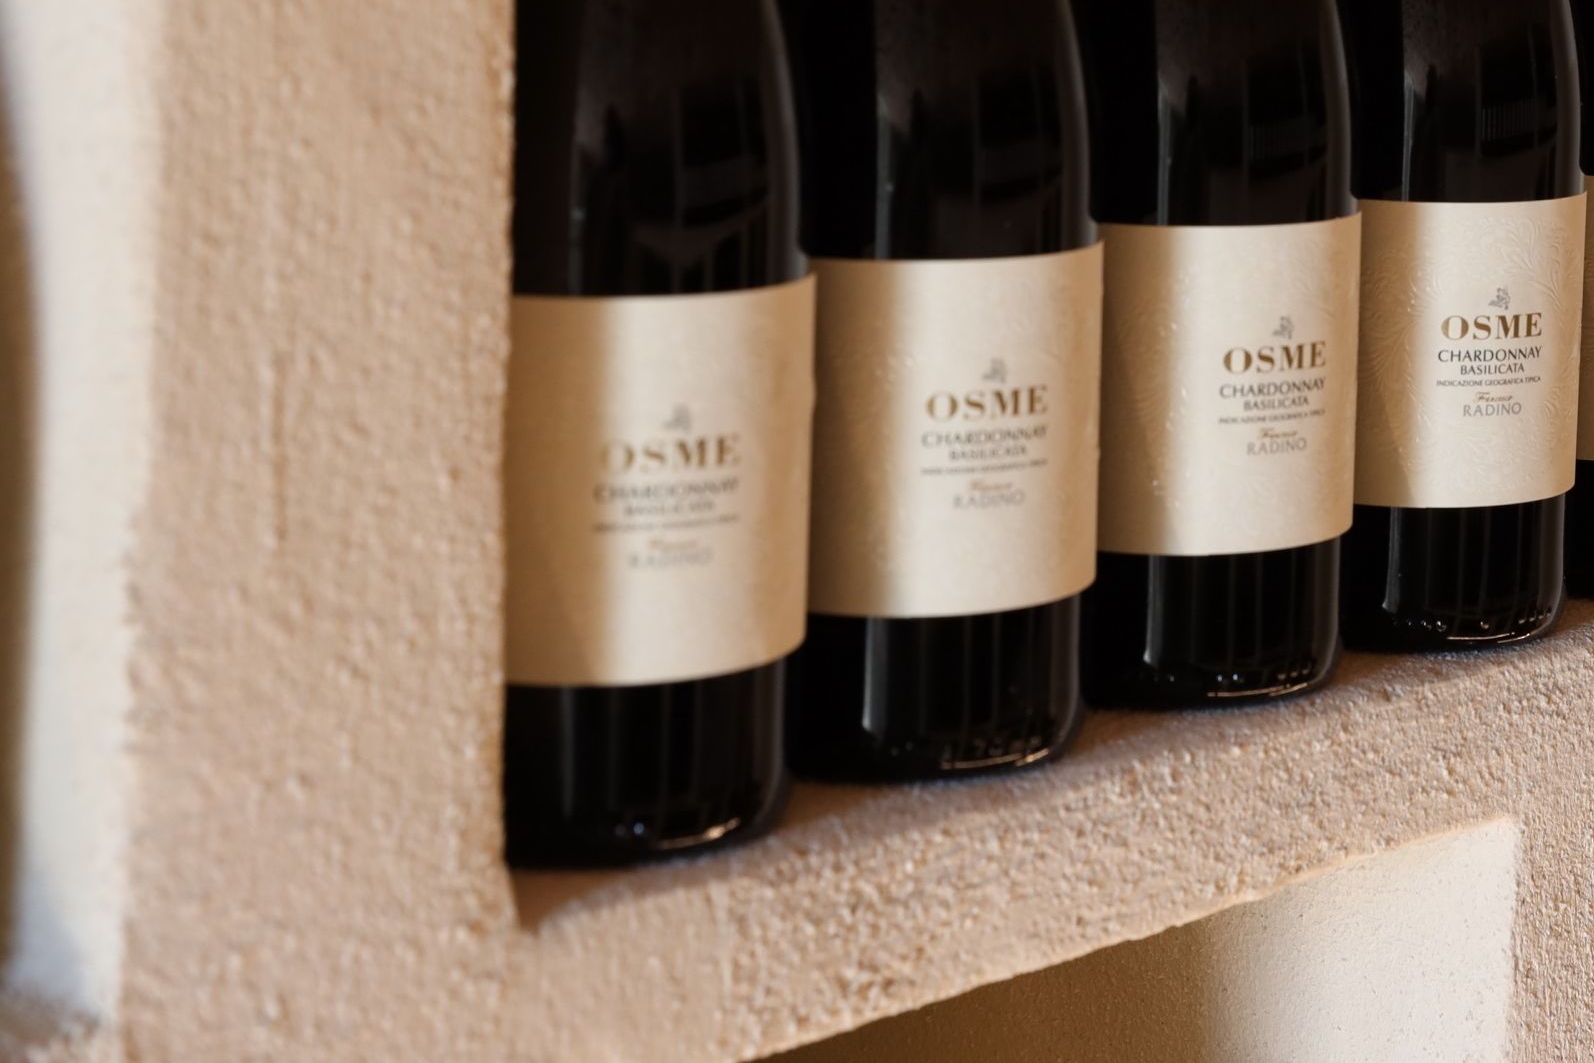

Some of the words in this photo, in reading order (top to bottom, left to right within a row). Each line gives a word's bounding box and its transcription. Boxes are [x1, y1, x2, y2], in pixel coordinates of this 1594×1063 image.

[1441, 312, 1542, 341] OSME
[1223, 341, 1326, 375] OSME
[1438, 346, 1542, 362] CHARDONNAY
[1460, 363, 1525, 375] BASILICATA
[1219, 377, 1326, 399] CHARDONNAY
[926, 385, 1048, 421] OSME
[1243, 396, 1309, 411] BASILICATA
[1463, 402, 1522, 417] RADINO
[921, 425, 1048, 448] CHARDONNAY
[1246, 438, 1307, 456] RADINO
[598, 434, 741, 474] OSME
